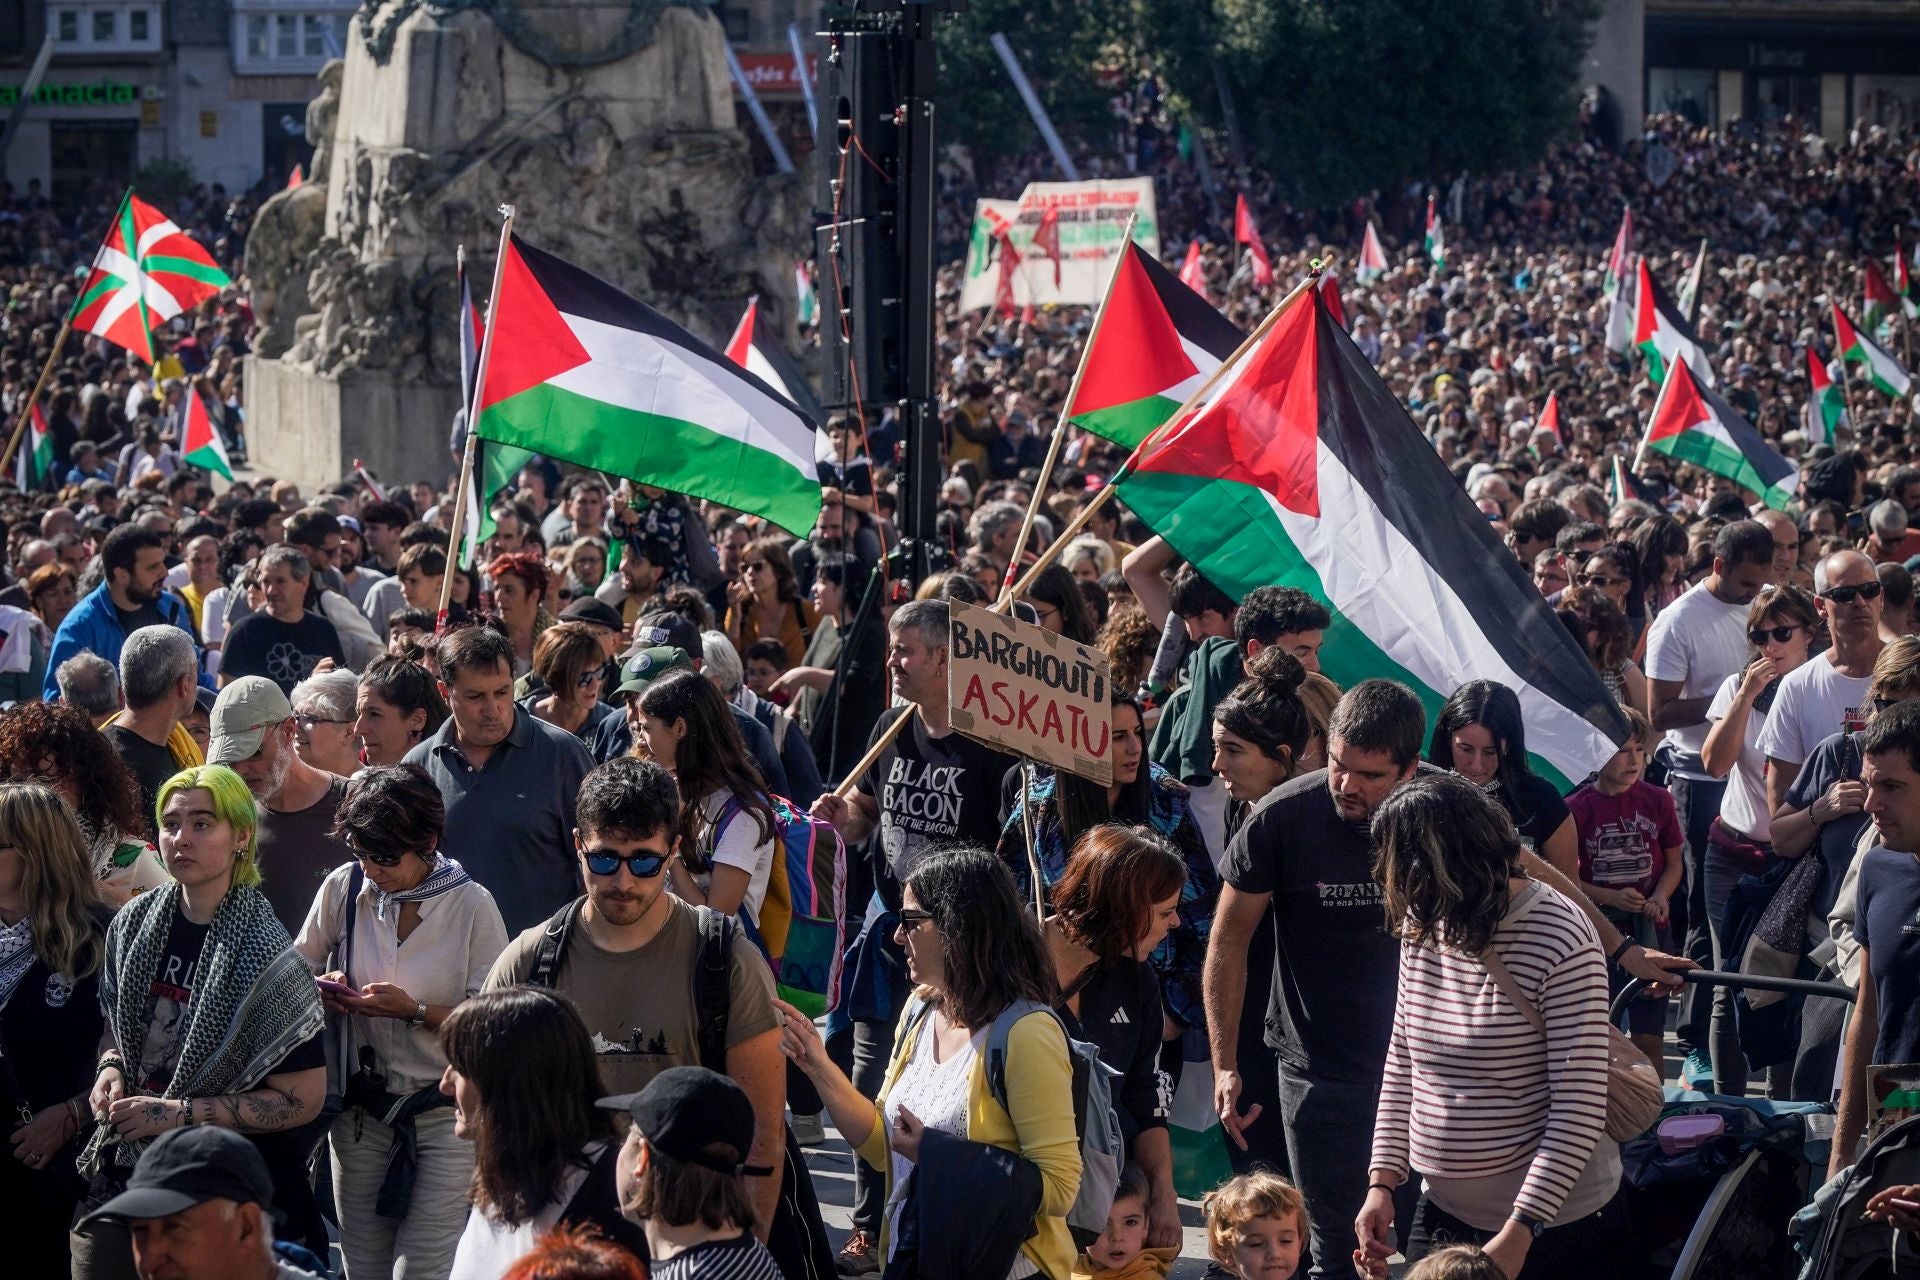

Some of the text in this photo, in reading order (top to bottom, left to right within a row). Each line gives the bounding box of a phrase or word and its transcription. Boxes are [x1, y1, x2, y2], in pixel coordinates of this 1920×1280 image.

[961, 673, 1109, 758] ASKATU
[887, 756, 966, 797] BLACK
[883, 784, 964, 826] BACON
[894, 814, 959, 837] EAT THE BACON!
[1325, 883, 1380, 898] 20 AN
